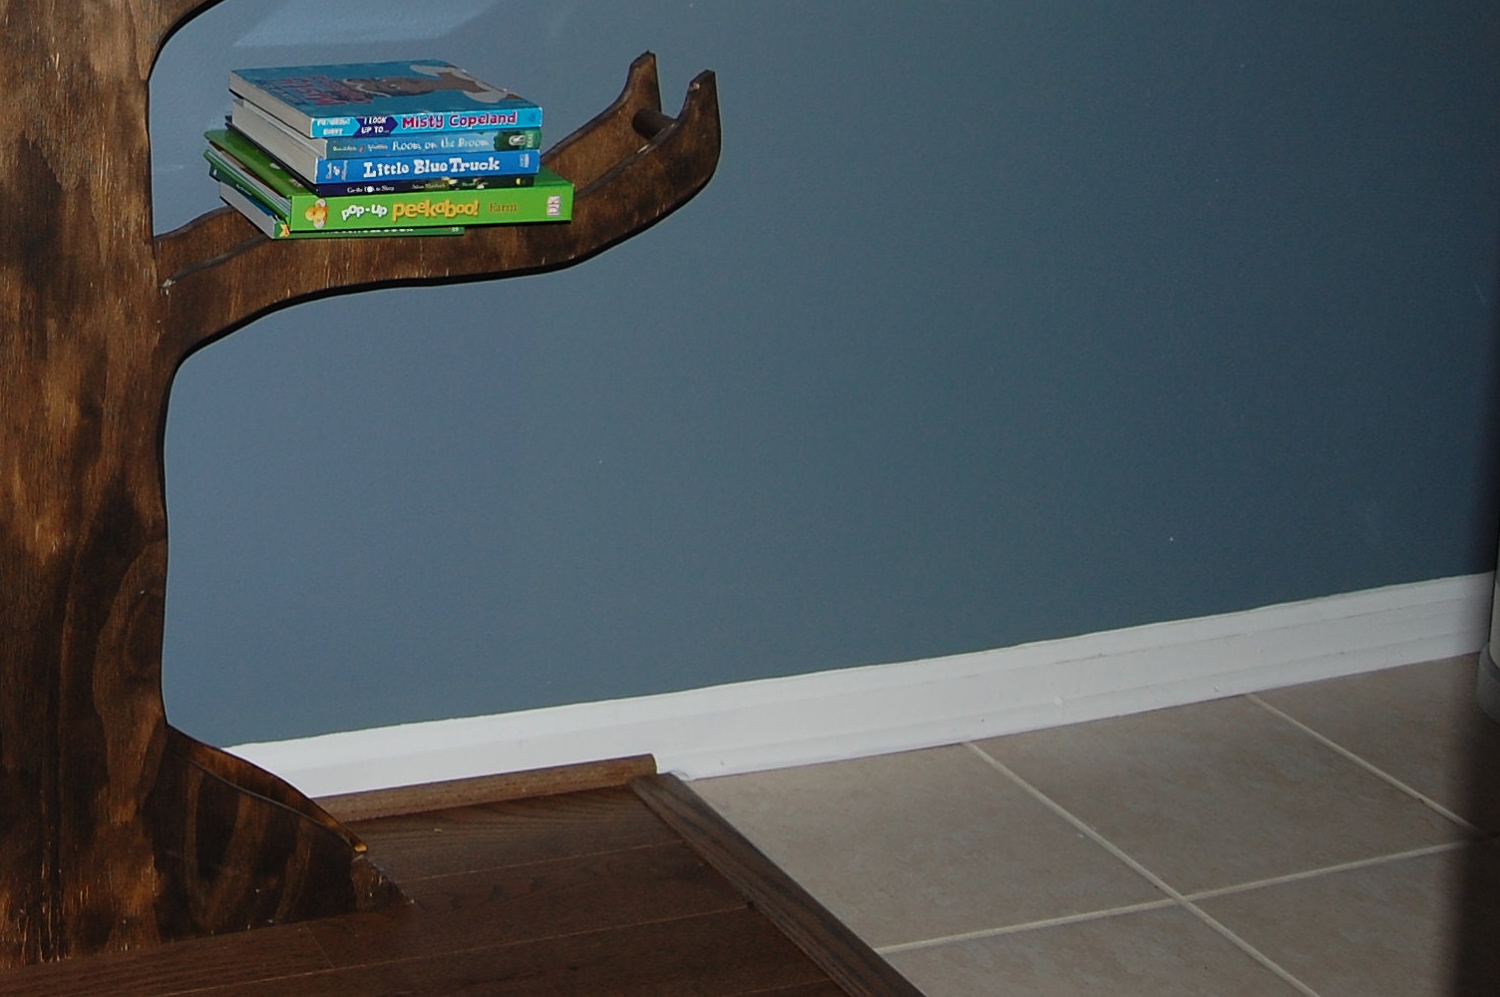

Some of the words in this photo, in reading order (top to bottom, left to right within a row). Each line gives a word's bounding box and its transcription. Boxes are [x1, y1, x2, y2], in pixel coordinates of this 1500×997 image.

[368, 115, 387, 124] LOOK
[401, 112, 445, 129] Misty
[448, 108, 517, 129] Copeland
[360, 125, 373, 134] UP
[391, 137, 421, 151] Room
[423, 139, 439, 150] on
[440, 136, 455, 148] the
[457, 135, 490, 148] Broom
[362, 159, 409, 177] Little
[412, 157, 448, 172] Blue
[447, 155, 500, 171] Truck
[340, 202, 388, 219] pop-up
[390, 197, 480, 221] peekaboo!
[488, 199, 518, 211] Farm
